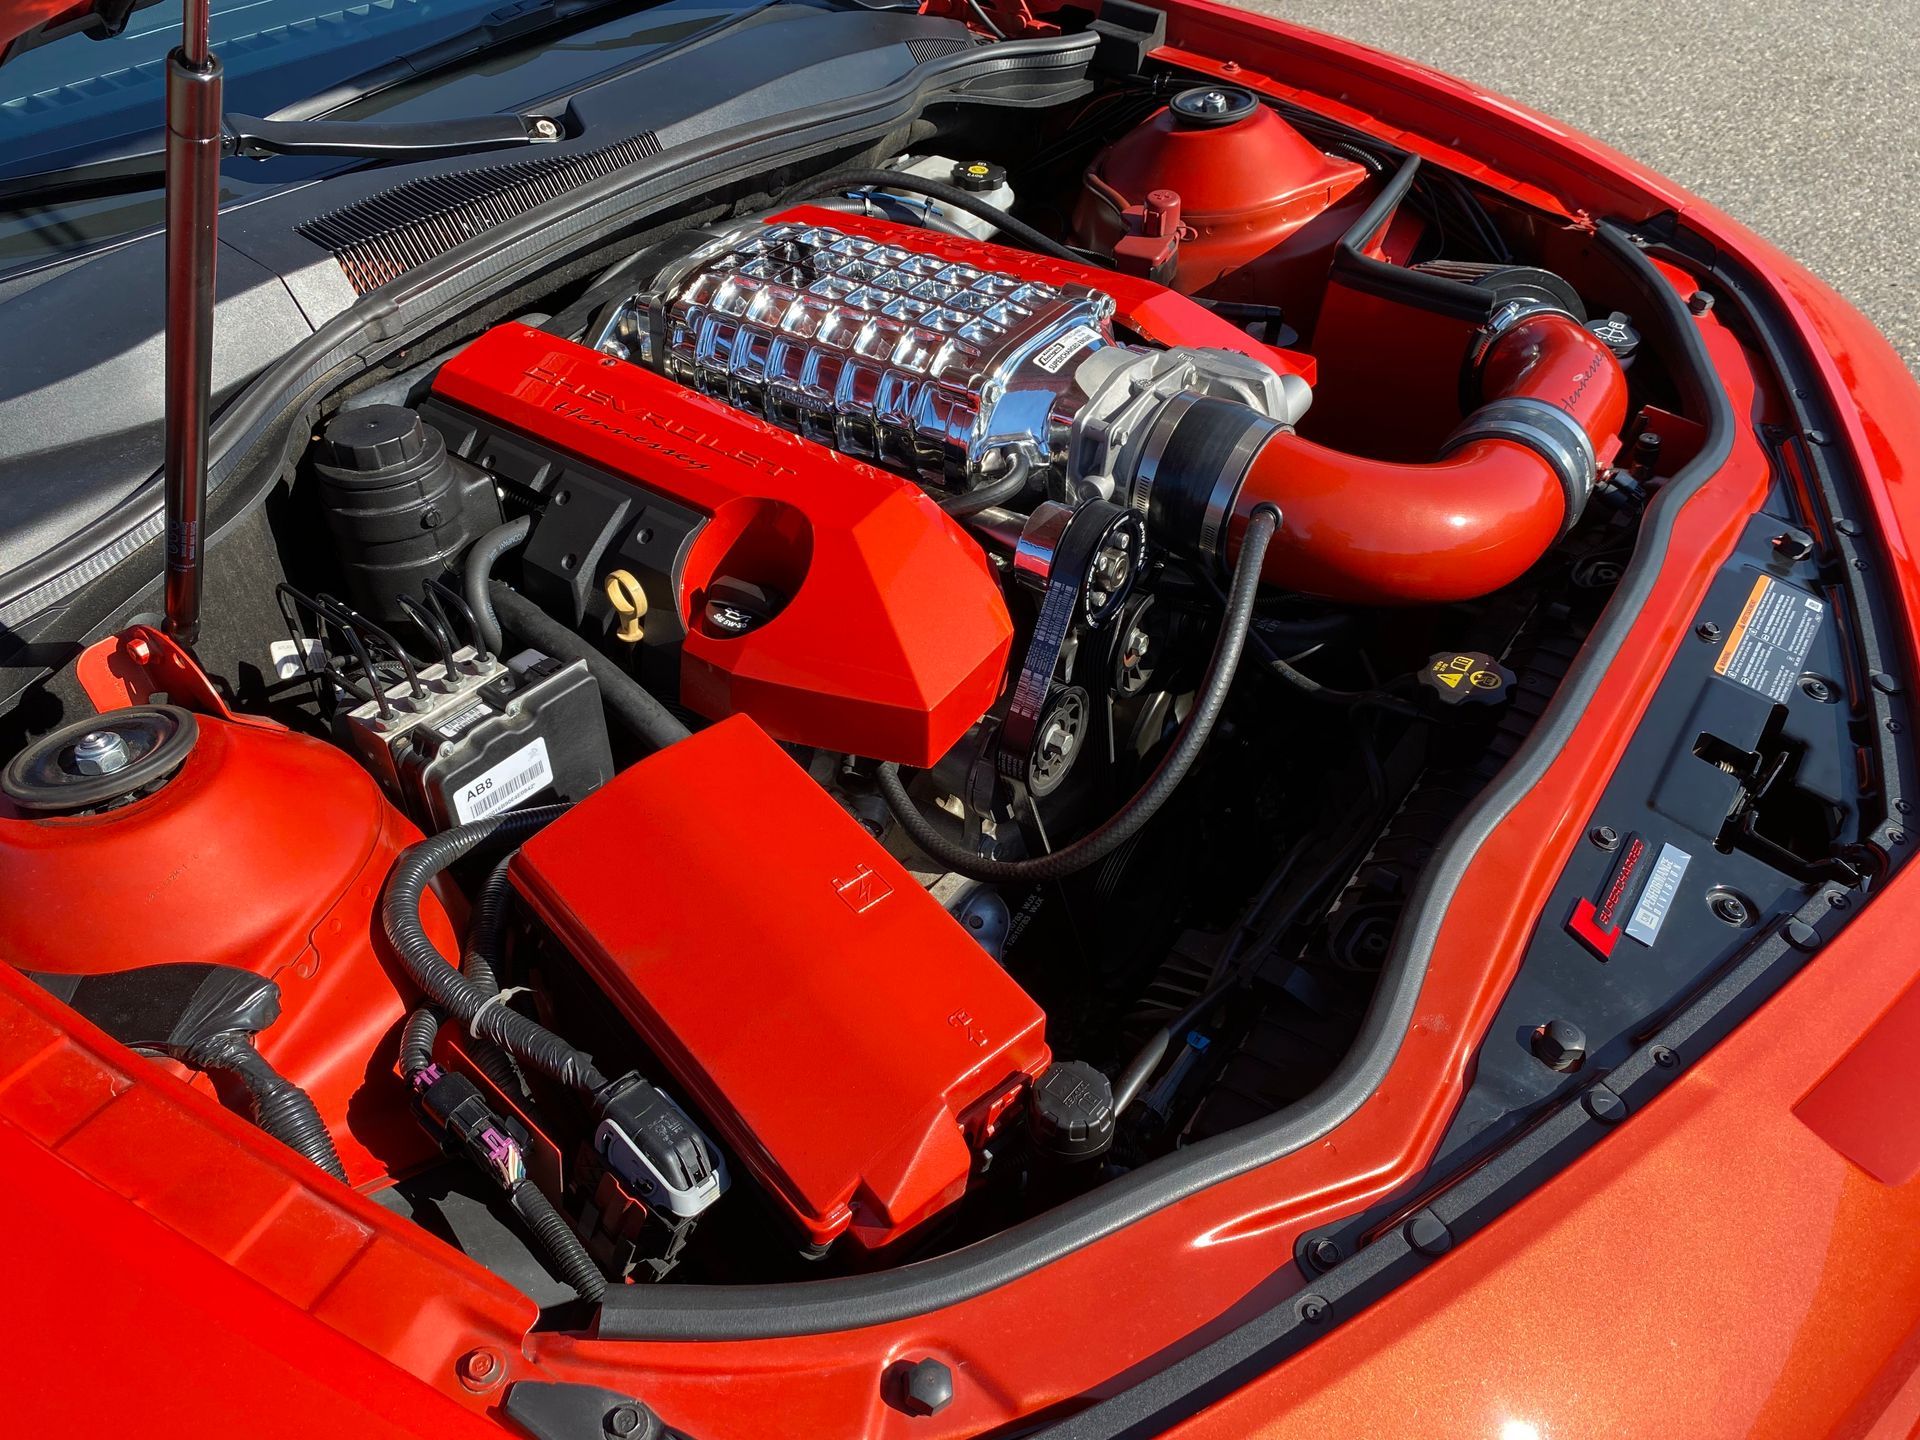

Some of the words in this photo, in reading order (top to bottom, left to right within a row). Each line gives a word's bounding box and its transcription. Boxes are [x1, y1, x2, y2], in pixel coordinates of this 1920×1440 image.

[523, 367, 797, 477] CHEVROLET
[552, 401, 711, 470] Hennessey
[466, 777, 493, 803] AB8
[1599, 838, 1645, 925] SUPERCHARGED
[1642, 856, 1674, 910] PERFORMANCE
[1653, 863, 1682, 915] DIVISION
